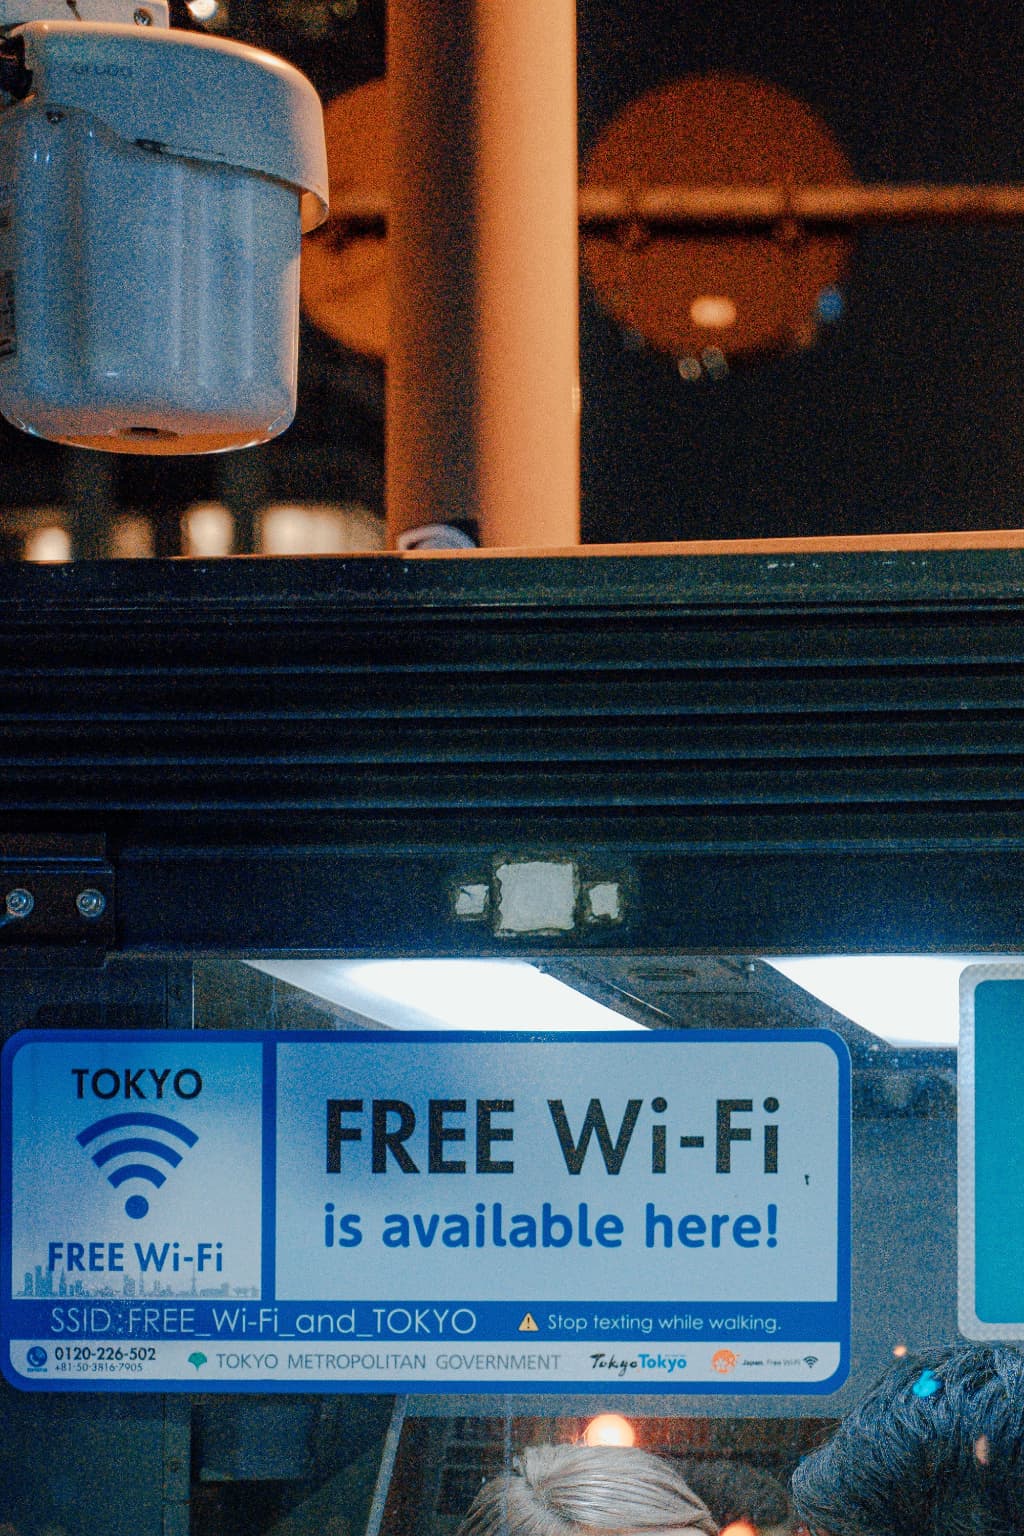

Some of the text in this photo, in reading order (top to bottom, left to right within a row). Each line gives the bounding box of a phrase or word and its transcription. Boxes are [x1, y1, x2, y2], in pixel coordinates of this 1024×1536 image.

[71, 1068, 204, 1100] TOKYO
[325, 1096, 780, 1176] FREE Wi-Fi
[324, 1202, 778, 1249] is available here!
[48, 1241, 224, 1273] FREE Wi-Fi
[548, 1314, 782, 1334] Stop texting while walking.
[54, 1346, 156, 1361] 0120-226-502
[216, 1353, 562, 1371] TOKYO METROPOLITAN GOVERNMENT
